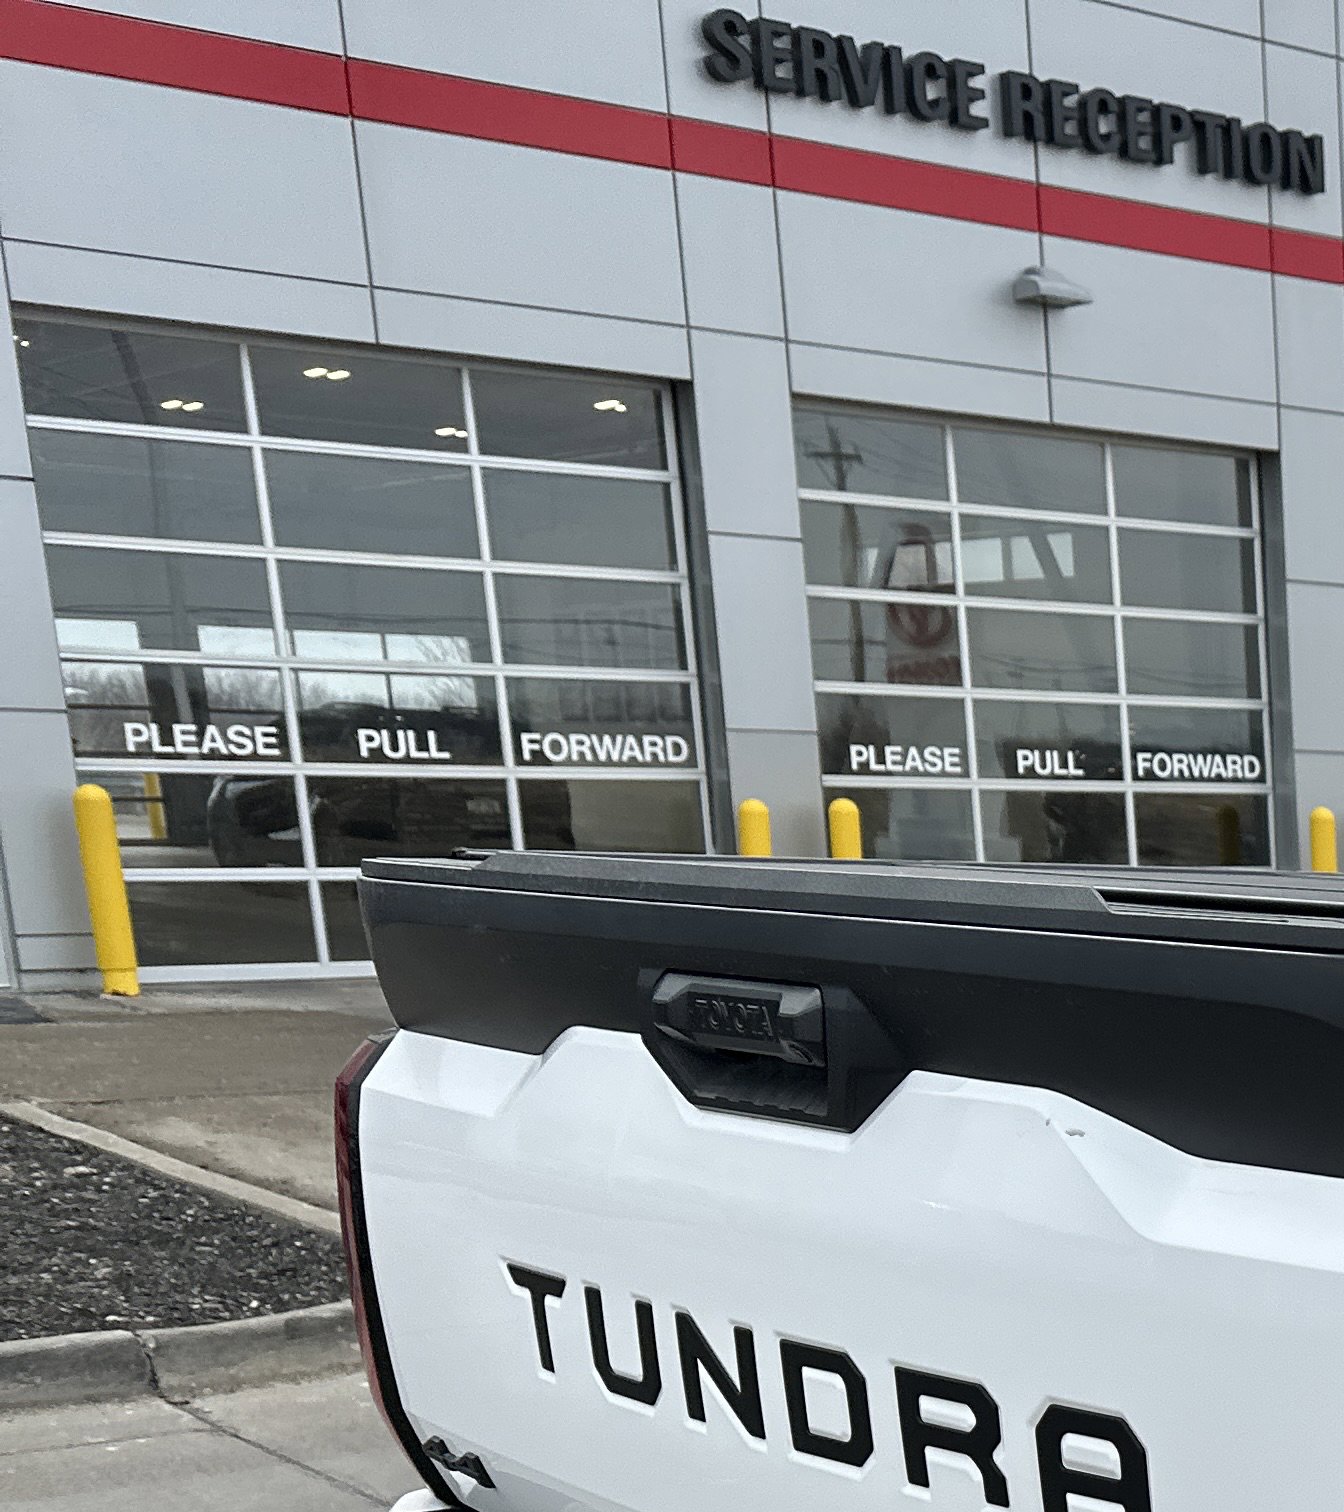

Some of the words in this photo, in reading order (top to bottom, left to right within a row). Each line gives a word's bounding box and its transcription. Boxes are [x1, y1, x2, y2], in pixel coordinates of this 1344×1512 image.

[702, 8, 989, 130] SERVICE
[998, 70, 1326, 196] RECEPTION
[123, 722, 281, 756] PLEASE
[356, 727, 452, 760] PULL
[519, 731, 690, 764] FORWARD
[849, 743, 962, 773] PLEASE
[1015, 748, 1086, 777] PULL
[1135, 751, 1261, 780] FORWARD
